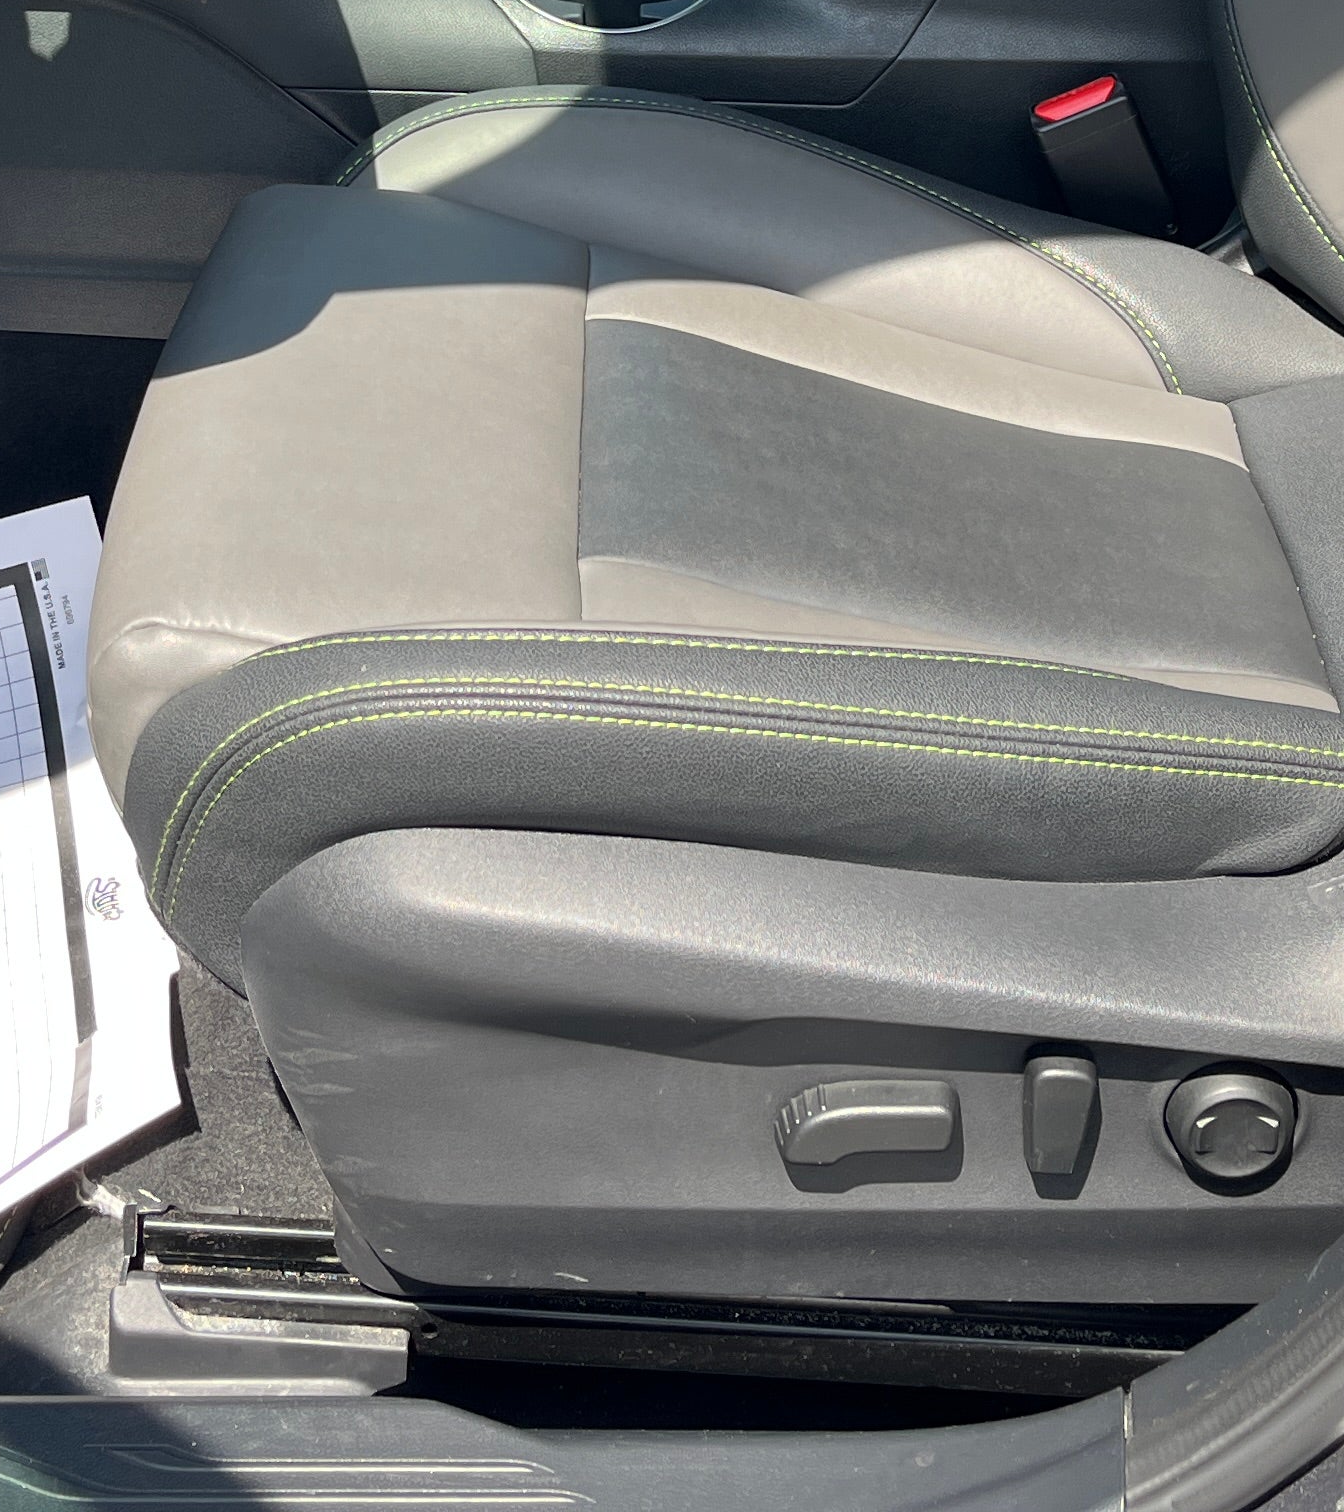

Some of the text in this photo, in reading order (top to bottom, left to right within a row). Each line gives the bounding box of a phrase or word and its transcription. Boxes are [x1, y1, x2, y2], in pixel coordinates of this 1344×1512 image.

[47, 611, 57, 630] THE
[51, 631, 60, 641] IN
[52, 642, 65, 669] MADE
